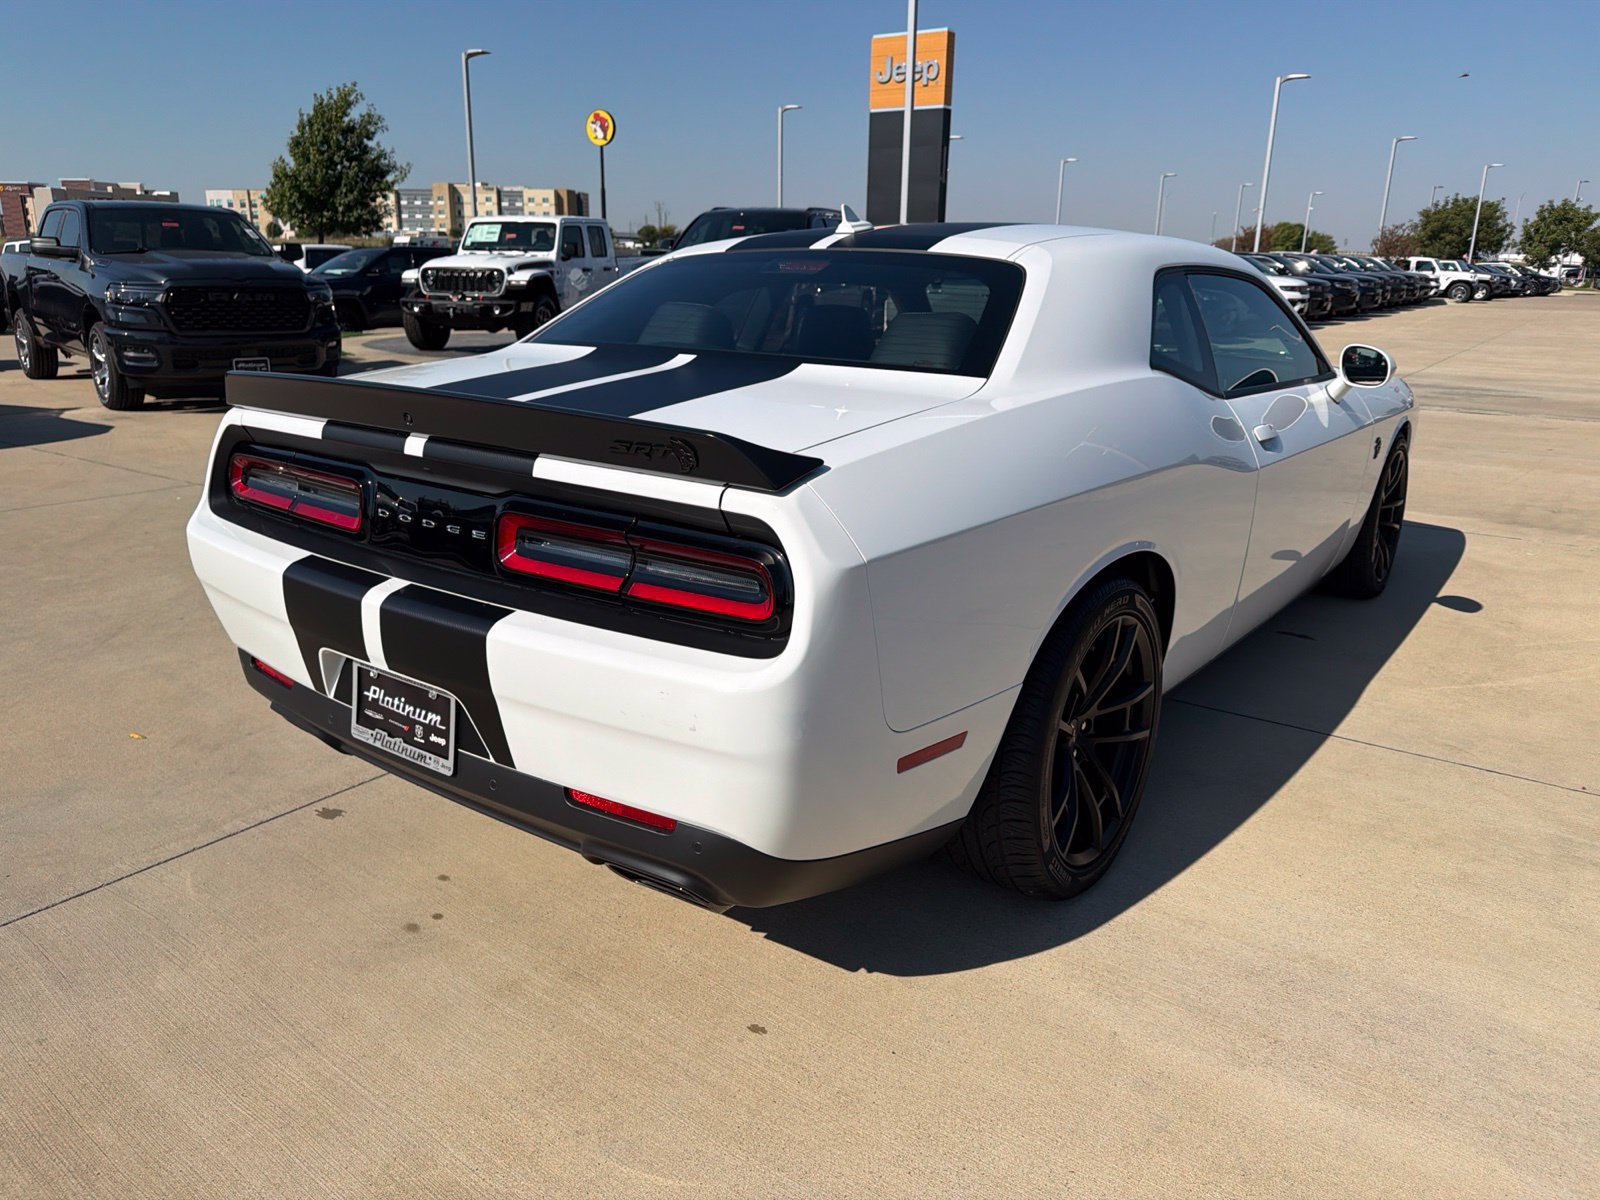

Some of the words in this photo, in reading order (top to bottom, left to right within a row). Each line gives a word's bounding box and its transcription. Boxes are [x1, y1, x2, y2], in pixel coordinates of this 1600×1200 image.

[876, 56, 940, 87] Jeep
[608, 439, 672, 461] SRT
[377, 507, 486, 540] DODGE
[363, 685, 446, 730] Platinum
[373, 731, 432, 765] Platinum
